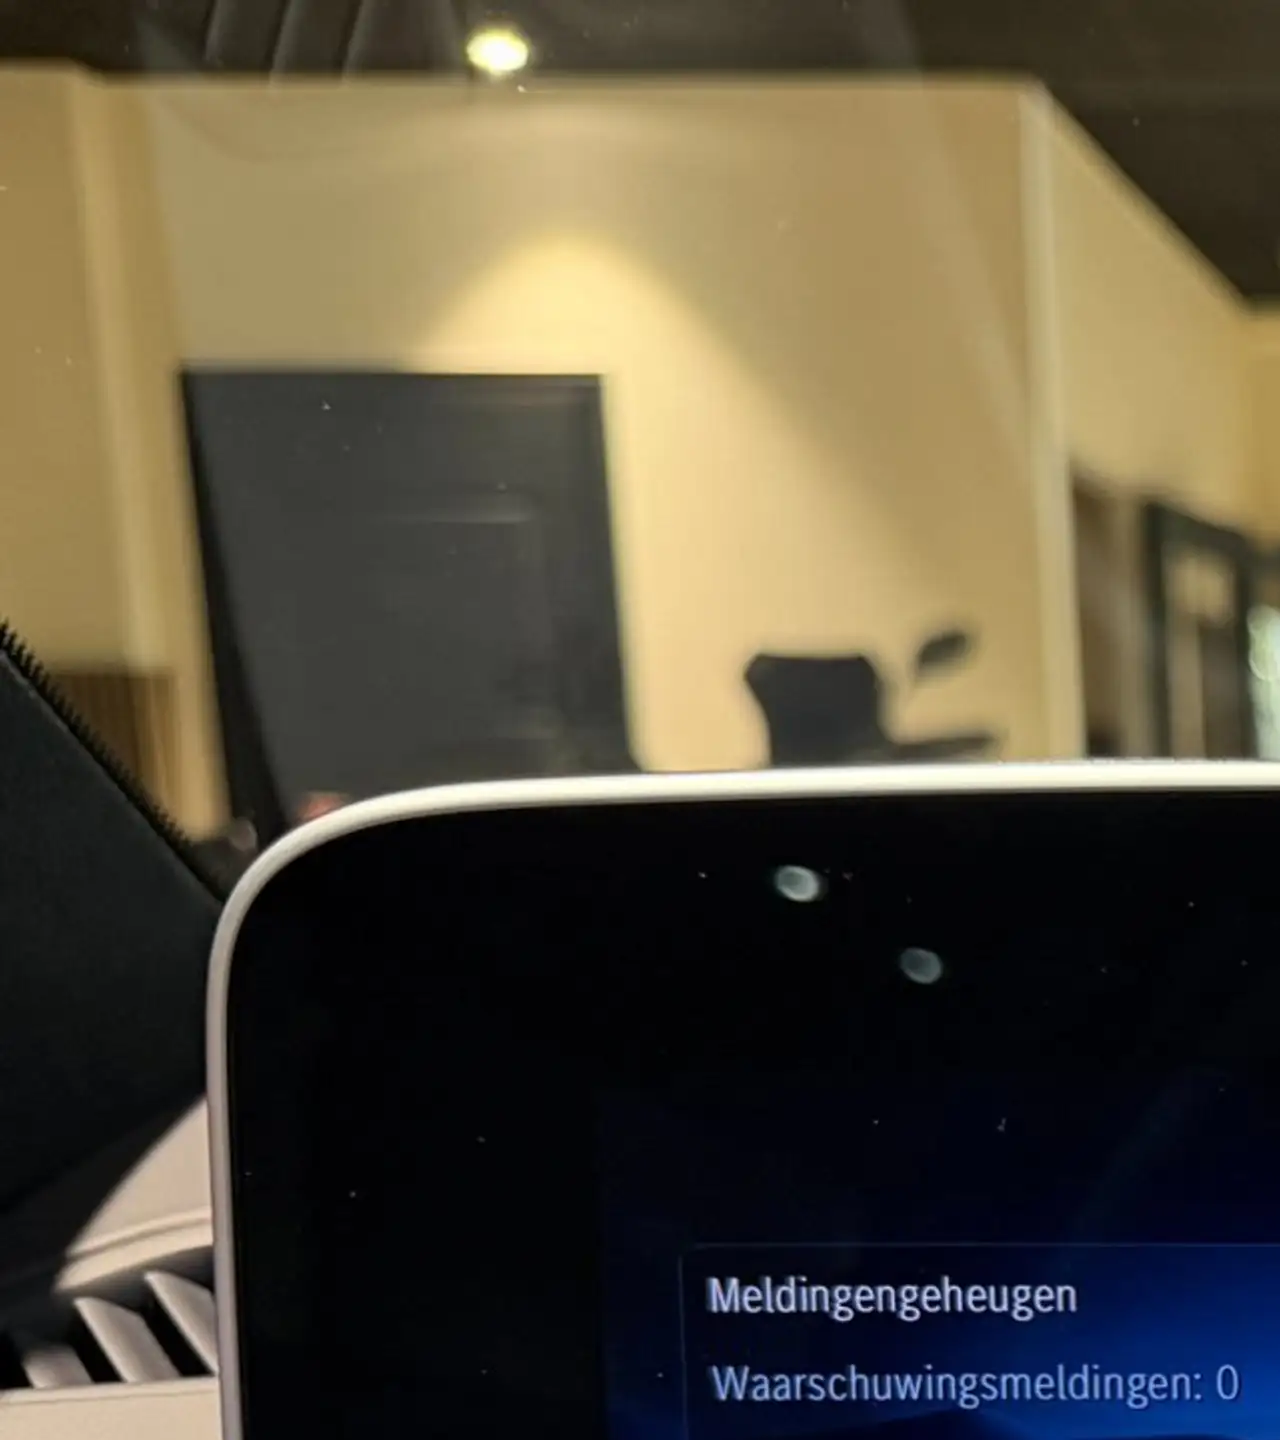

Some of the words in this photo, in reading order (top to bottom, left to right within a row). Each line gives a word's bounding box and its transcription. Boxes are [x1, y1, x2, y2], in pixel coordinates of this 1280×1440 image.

[707, 1276, 1077, 1320] Meldingengeheugen
[711, 1365, 1204, 1409] Waarschuwingsmeldingen:
[1216, 1365, 1239, 1400] 0
